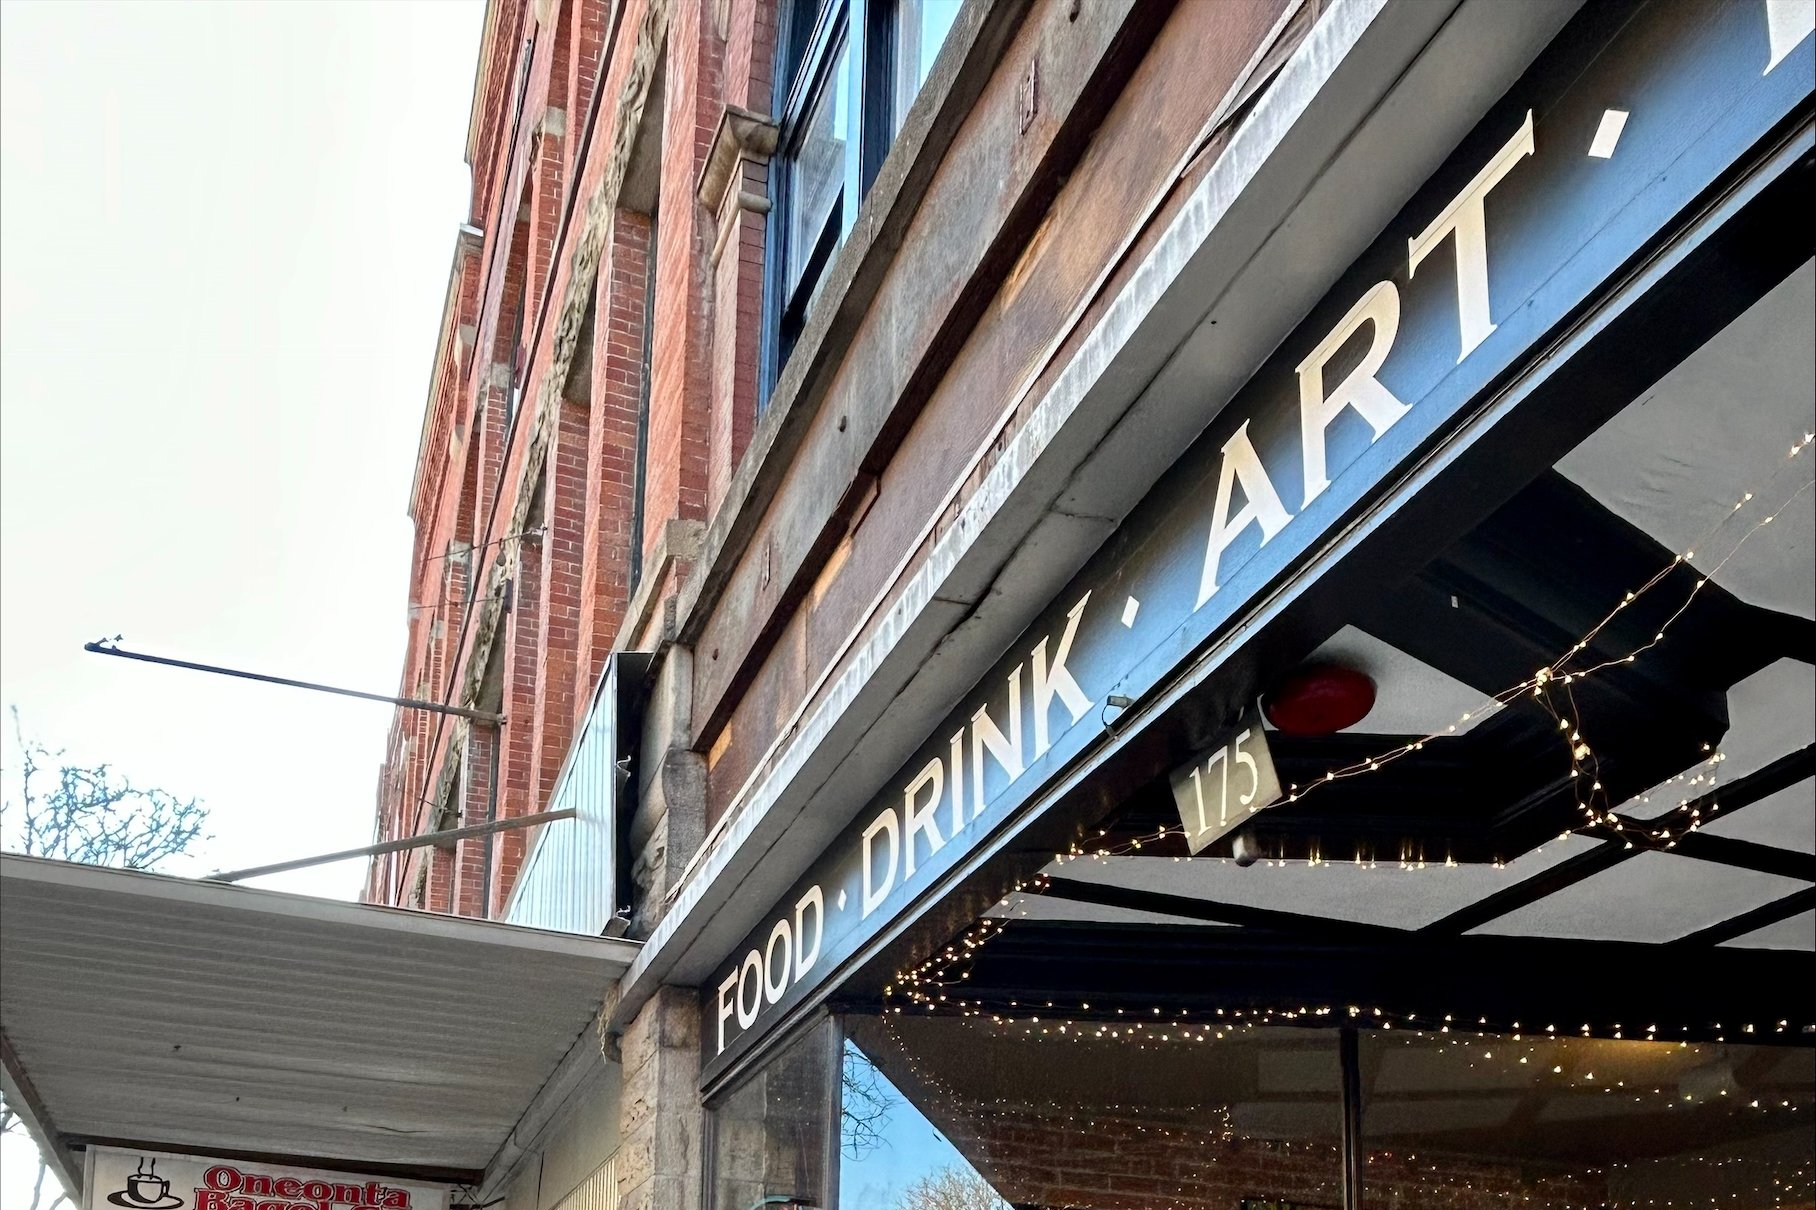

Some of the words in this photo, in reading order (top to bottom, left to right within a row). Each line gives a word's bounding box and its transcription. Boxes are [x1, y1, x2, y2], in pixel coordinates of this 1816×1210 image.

[716, 883, 824, 1056] FOOD
[861, 589, 1095, 921] DRINK
[1193, 107, 1536, 613] ART
[1189, 728, 1258, 837] 175
[203, 1164, 412, 1210] Oneonta
